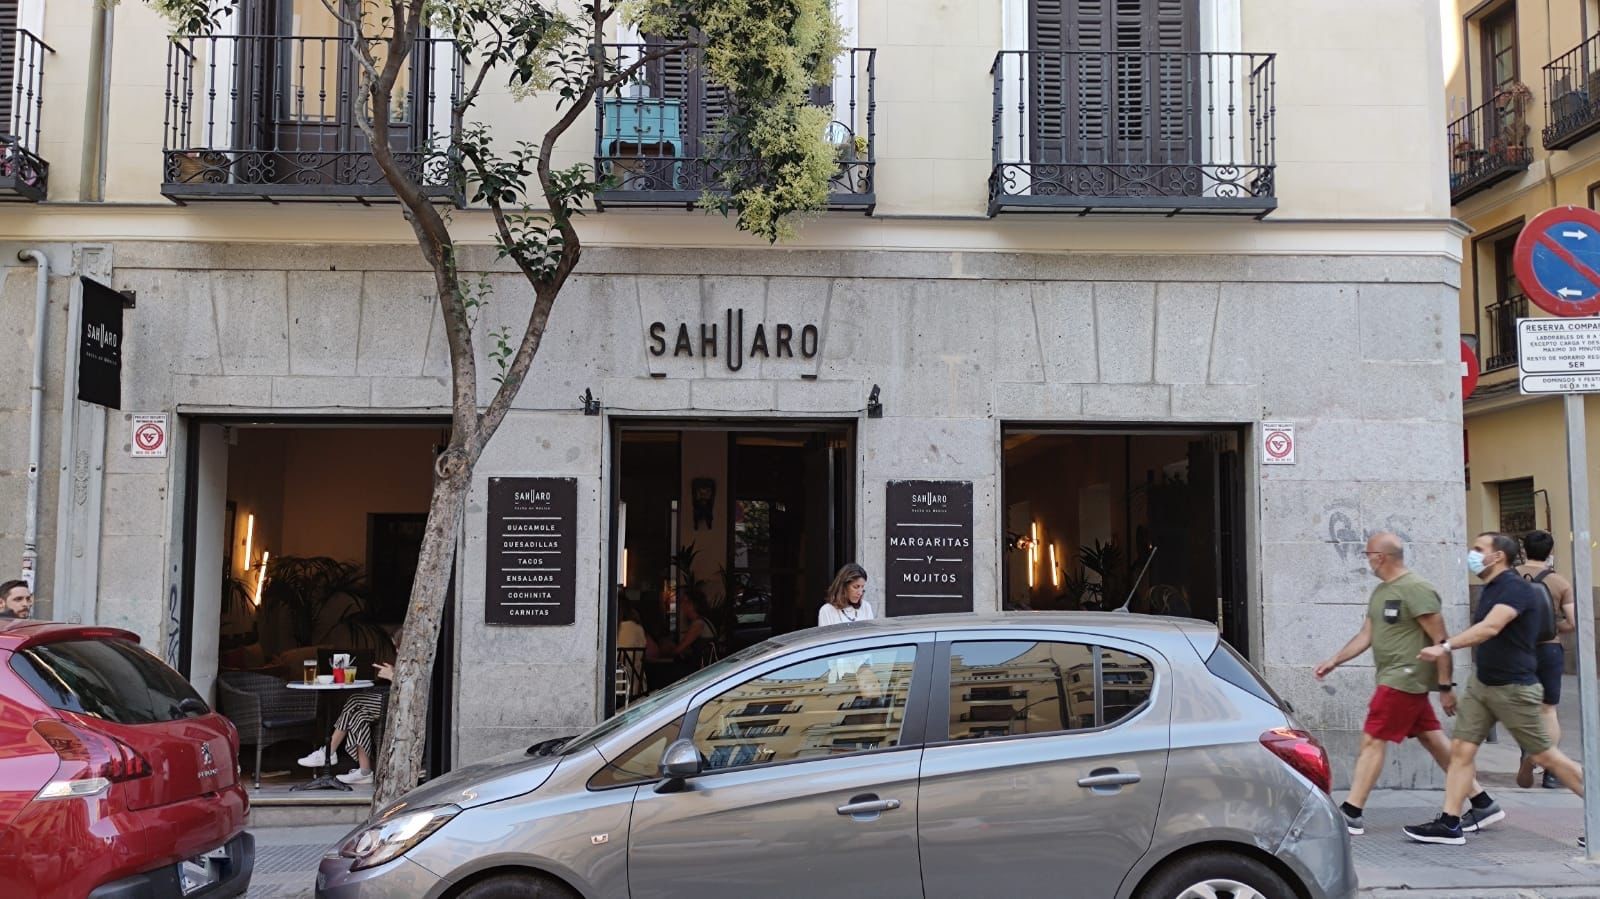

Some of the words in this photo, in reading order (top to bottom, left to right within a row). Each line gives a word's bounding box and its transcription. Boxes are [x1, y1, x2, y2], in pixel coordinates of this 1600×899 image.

[1526, 324, 1565, 332] RESERVA
[87, 323, 118, 349] SAHUARO
[649, 308, 819, 372] SAHUARO
[514, 489, 551, 504] SAHUARO
[911, 491, 947, 506] SAHUARO
[890, 537, 969, 547] MARGARITAS
[926, 555, 933, 564] Y
[903, 573, 956, 583] MOJITOS
